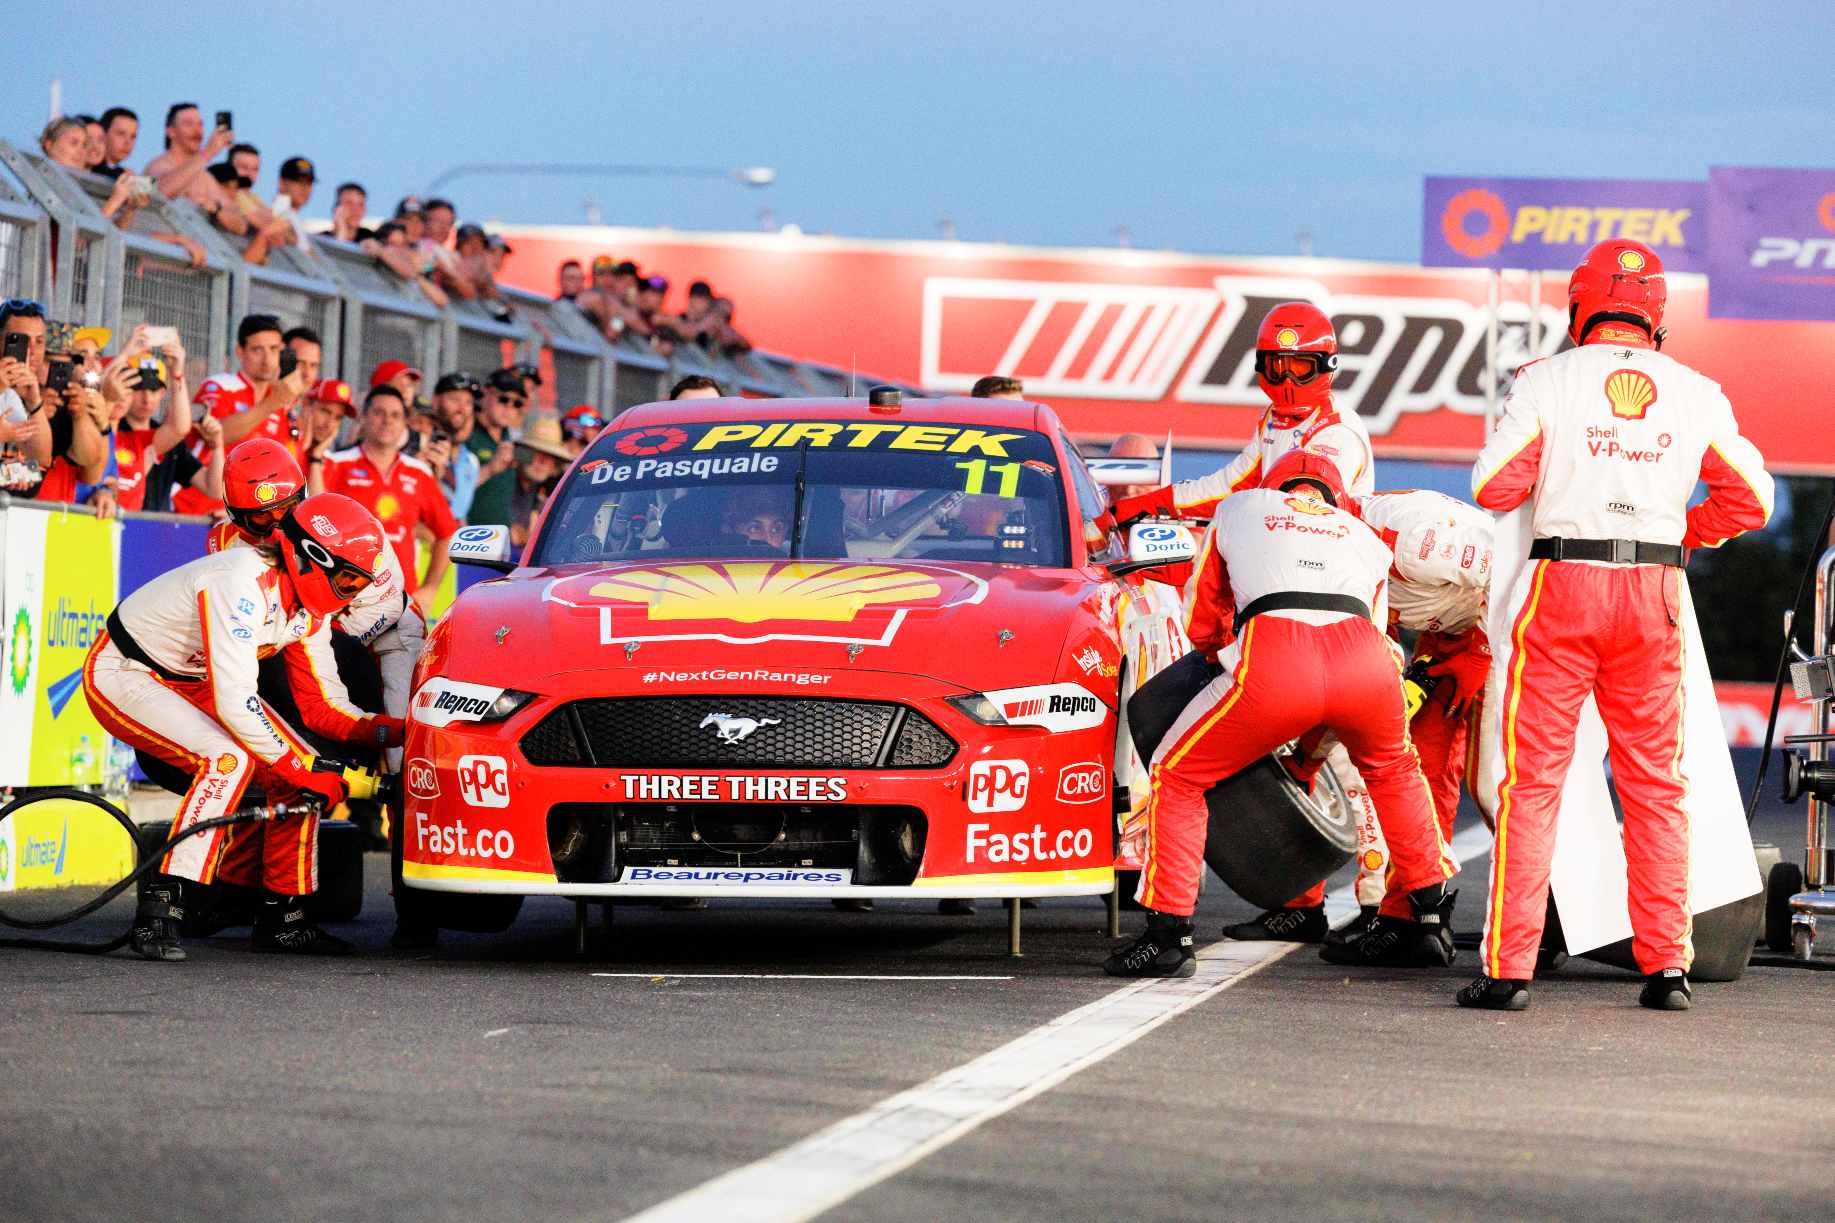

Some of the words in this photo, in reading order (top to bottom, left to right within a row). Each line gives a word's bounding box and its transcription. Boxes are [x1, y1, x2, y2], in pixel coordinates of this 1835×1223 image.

[1511, 205, 1691, 246] PIRTEK
[692, 423, 1026, 458] PIRTEK
[1586, 427, 1618, 439] Shell
[1587, 441, 1664, 463] V-Power
[591, 462, 631, 485] De
[636, 453, 779, 480] Pasquale
[955, 459, 1020, 498] 11
[1265, 522, 1345, 539] V-Power
[450, 542, 490, 552] Doric
[1146, 541, 1190, 552] Doric
[642, 668, 832, 685] #NextGenRanger
[434, 690, 490, 716] Repco
[1047, 694, 1096, 714] Repco
[409, 767, 436, 791] CRC
[460, 759, 508, 803] PPG
[620, 774, 720, 801] THREE
[725, 774, 848, 802] THREES
[972, 764, 1027, 808] PPG
[1061, 769, 1101, 796] CRC
[415, 812, 514, 859] Fast.co
[966, 824, 1093, 864] Fast.co
[630, 868, 842, 883] Beaurepaires
